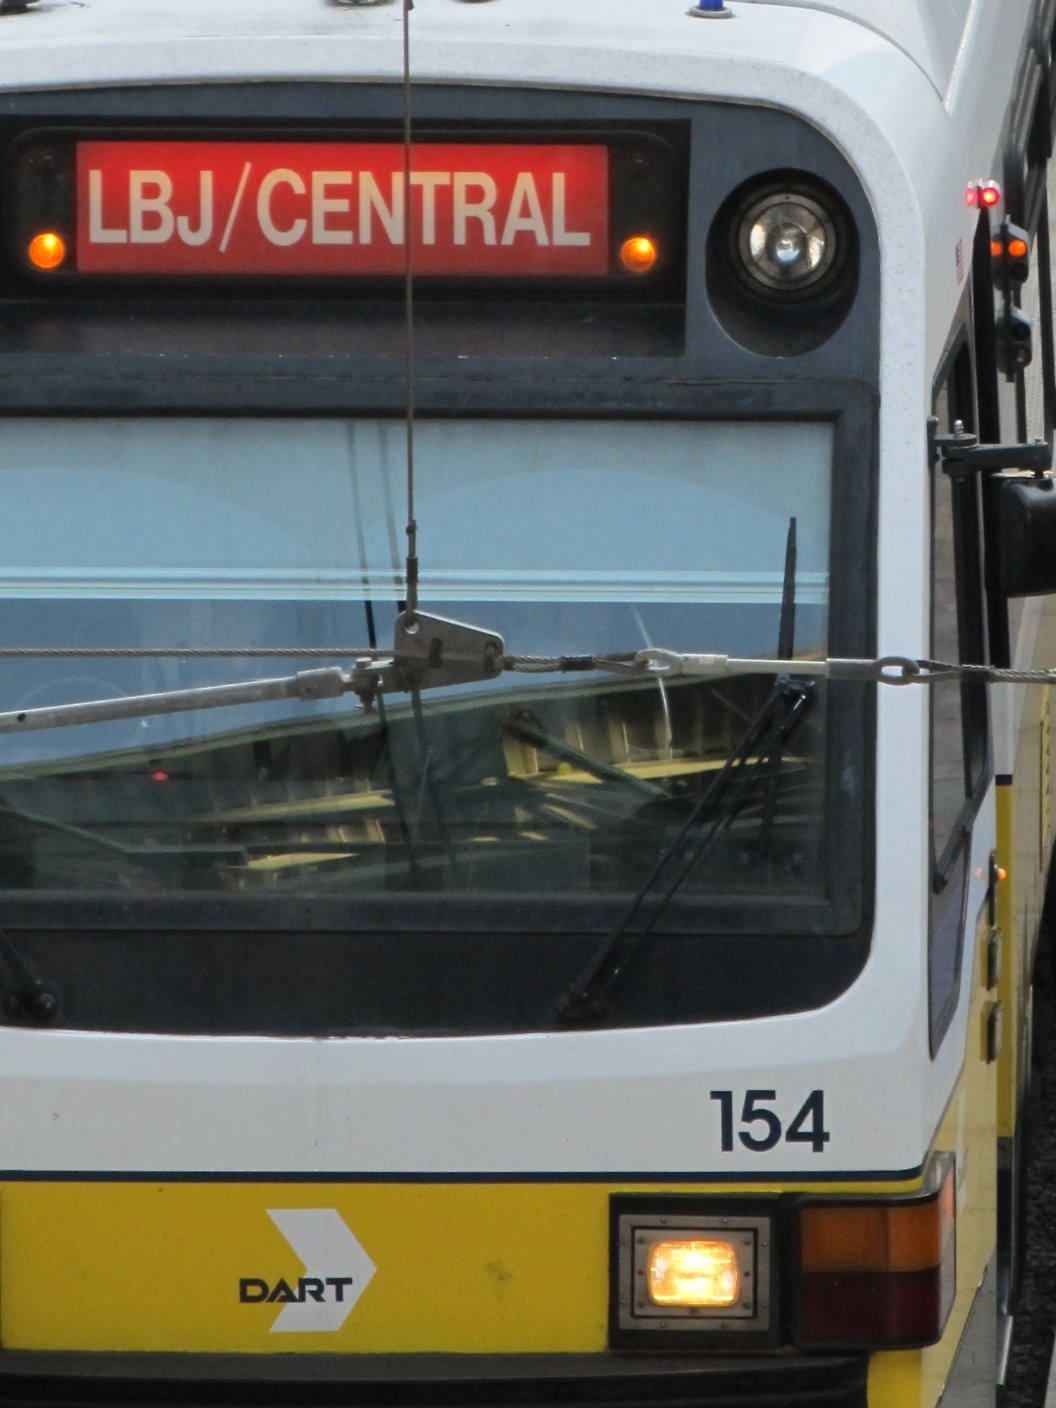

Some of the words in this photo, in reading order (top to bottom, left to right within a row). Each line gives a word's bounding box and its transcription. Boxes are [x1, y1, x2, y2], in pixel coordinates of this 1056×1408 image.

[88, 162, 591, 252] LBJ/CENTRAL
[710, 1089, 830, 1153] 154
[239, 1277, 352, 1302] DART
